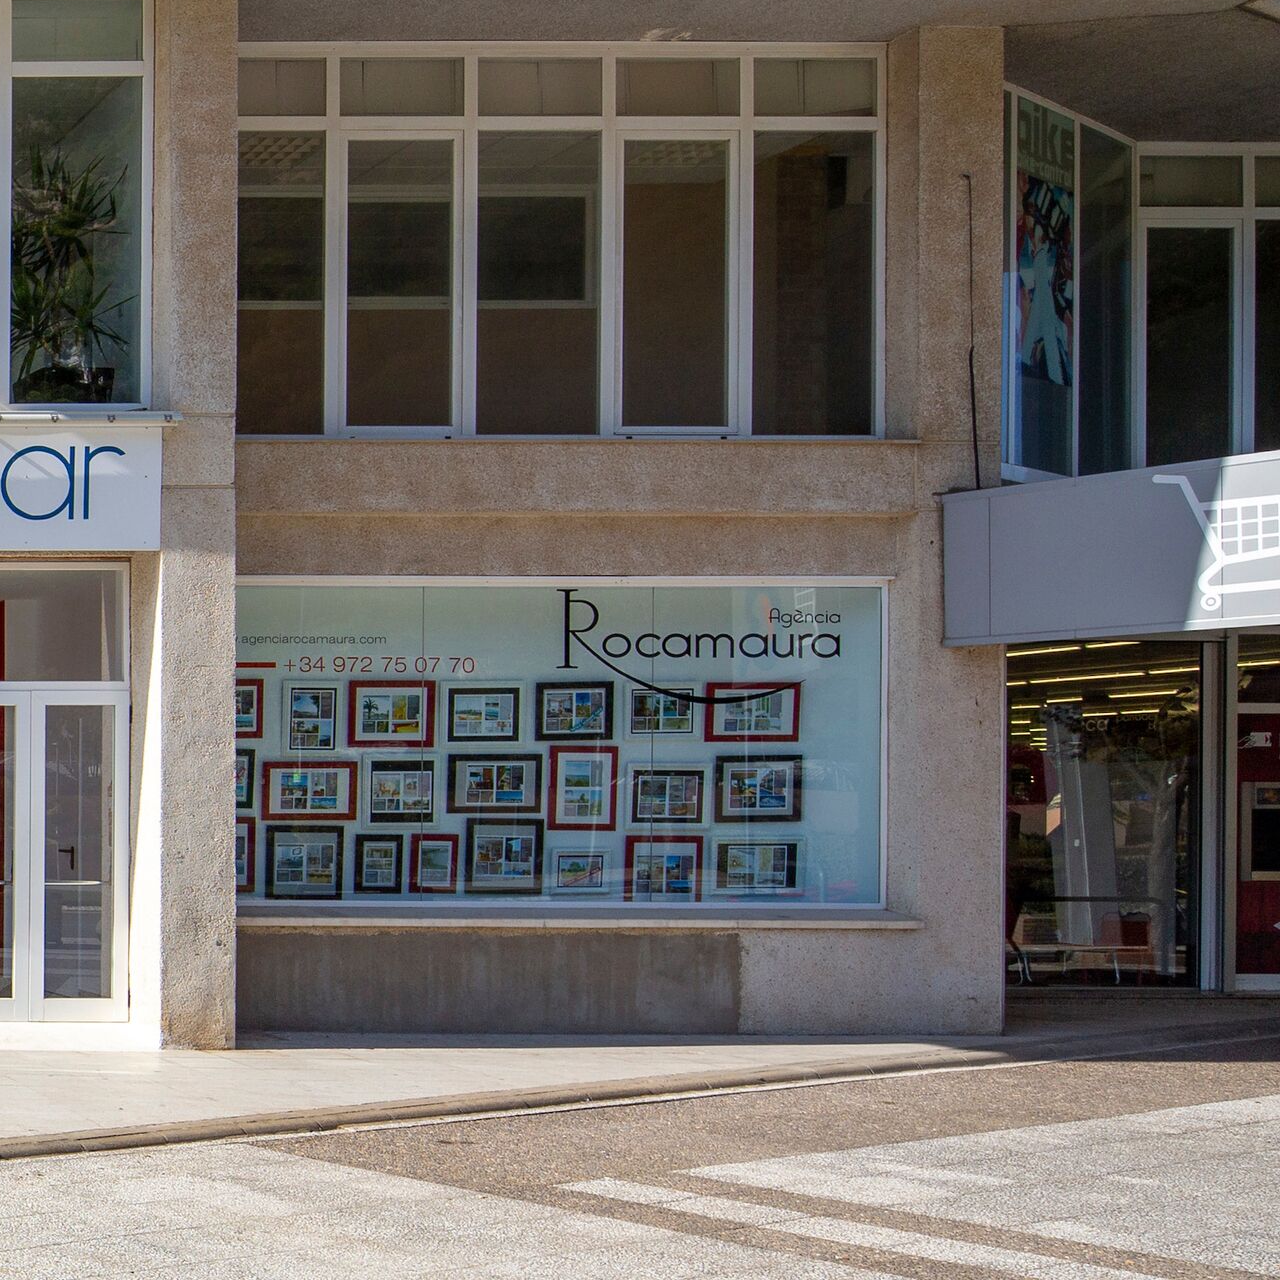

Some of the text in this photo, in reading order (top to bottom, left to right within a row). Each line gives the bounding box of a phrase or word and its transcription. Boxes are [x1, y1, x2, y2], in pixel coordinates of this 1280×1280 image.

[769, 607, 841, 628] Agència
[556, 588, 841, 671] Rocamaura
[284, 656, 475, 674] +34 972 75 07 70
